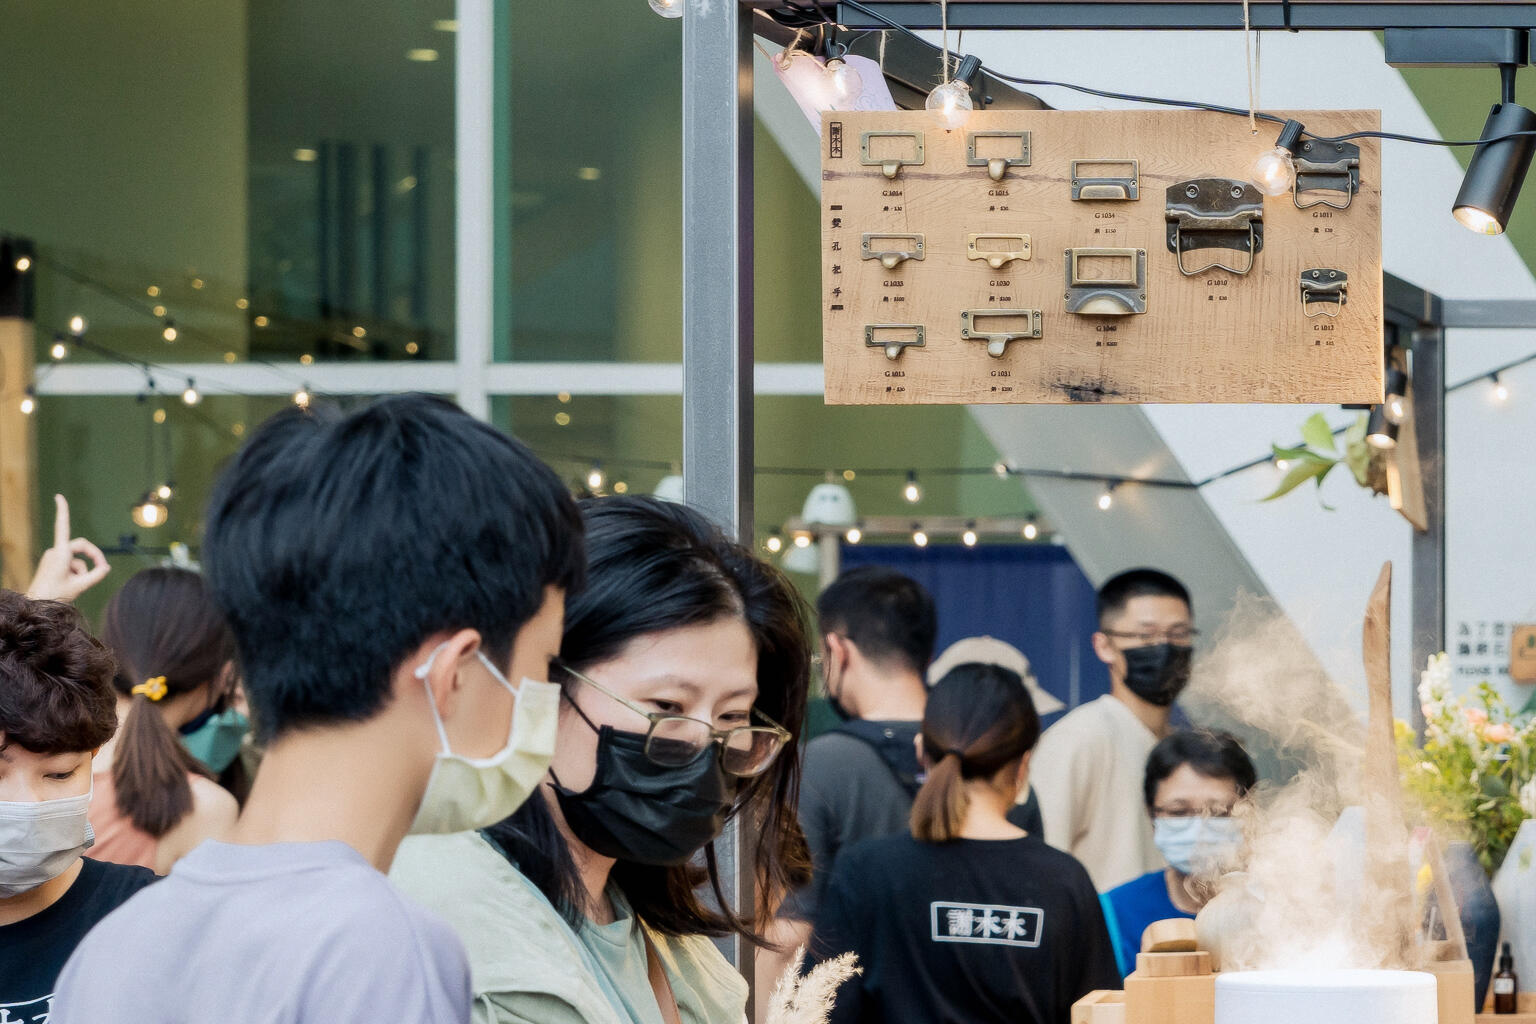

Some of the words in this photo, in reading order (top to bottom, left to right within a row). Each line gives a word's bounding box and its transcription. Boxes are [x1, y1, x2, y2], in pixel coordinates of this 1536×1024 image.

[831, 217, 842, 297] 雙孔把手
[945, 908, 1028, 941] 謝木木
